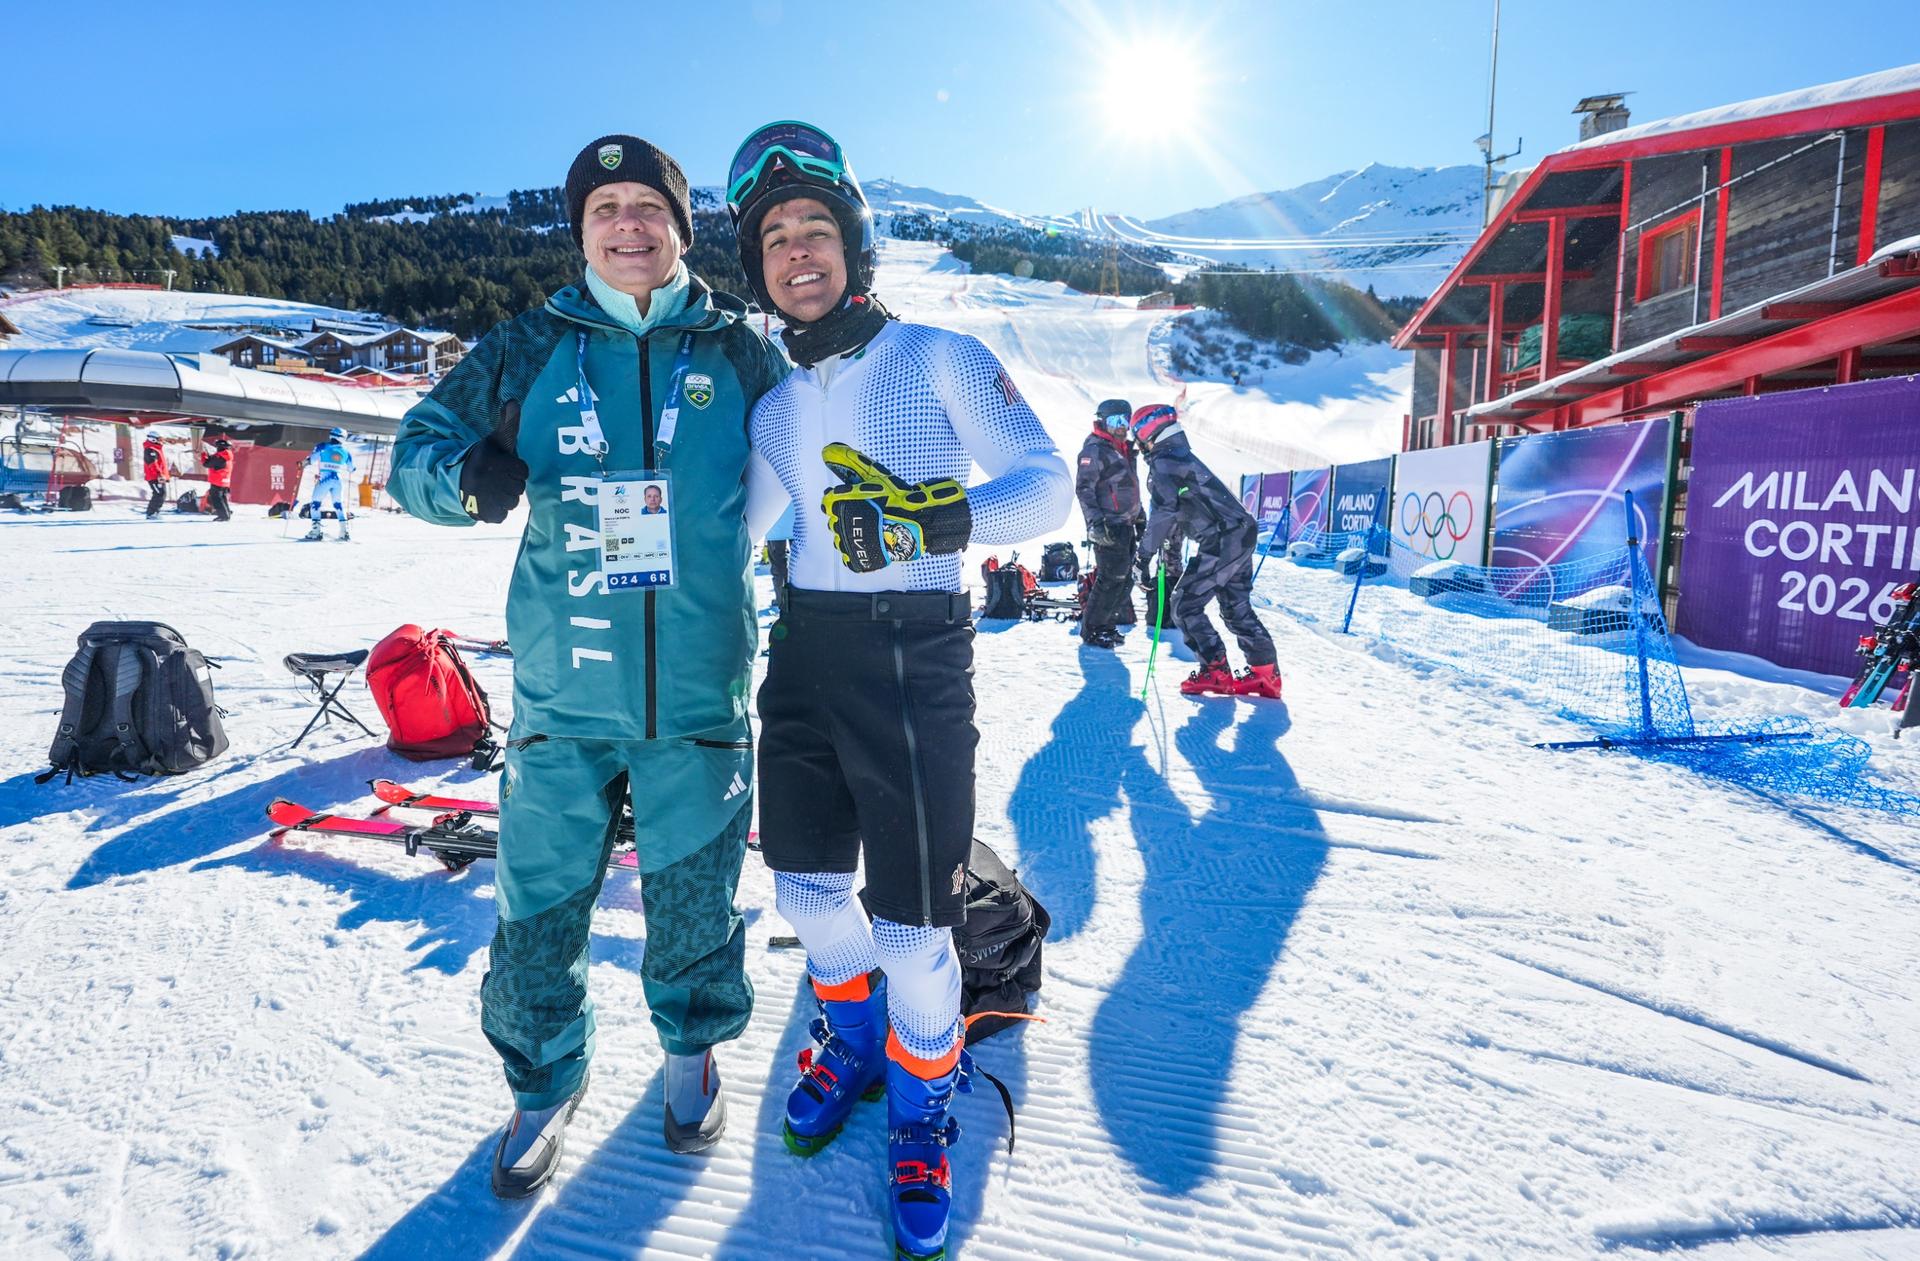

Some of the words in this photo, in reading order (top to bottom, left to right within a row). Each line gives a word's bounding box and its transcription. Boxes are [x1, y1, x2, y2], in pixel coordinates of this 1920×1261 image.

[1336, 493, 1375, 512] MILANO
[1712, 469, 1920, 514] MILAN
[853, 516, 870, 569] LEVEL
[1341, 514, 1375, 531] CORTIN
[557, 426, 613, 669] BRASIL
[1777, 570, 1900, 626] 2026
